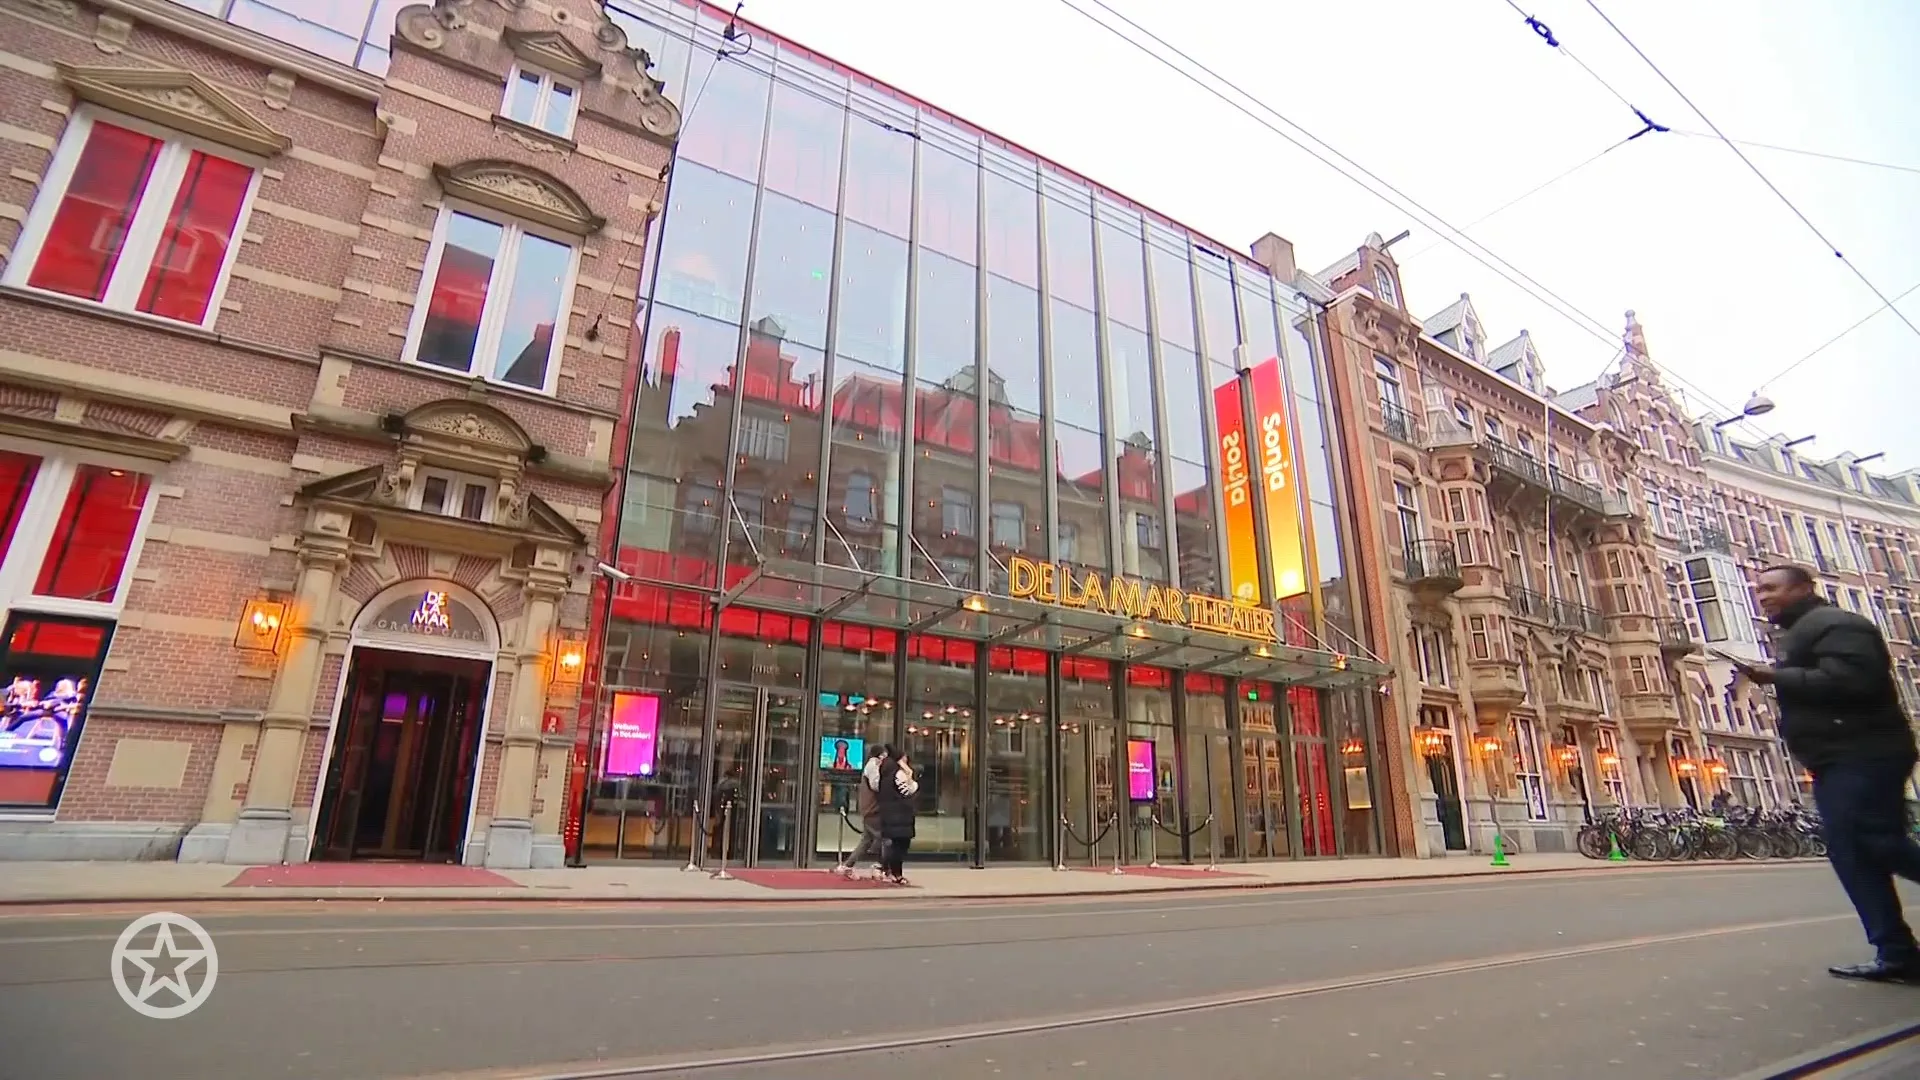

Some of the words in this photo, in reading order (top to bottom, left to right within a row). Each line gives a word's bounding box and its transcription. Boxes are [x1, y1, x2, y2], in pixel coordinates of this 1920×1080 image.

[425, 590, 448, 606] DE
[420, 600, 441, 615] LA
[411, 610, 450, 629] MAR
[1189, 597, 1278, 638] THEATER
